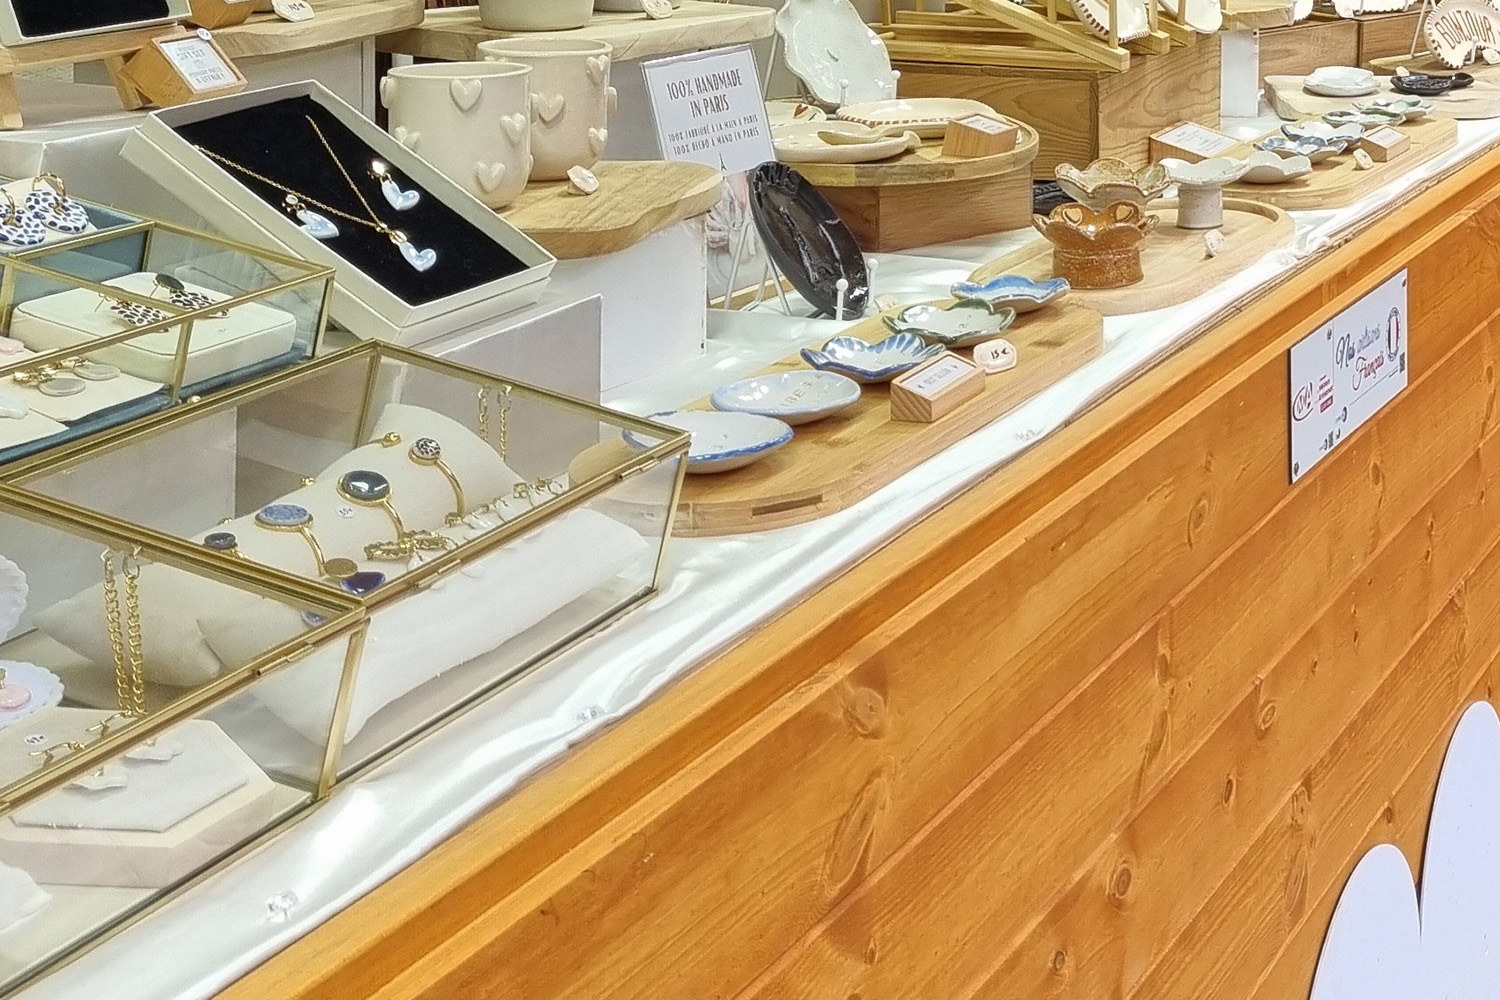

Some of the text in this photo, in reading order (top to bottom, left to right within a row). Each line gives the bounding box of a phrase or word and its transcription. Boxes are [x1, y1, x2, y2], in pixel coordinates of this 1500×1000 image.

[1434, 9, 1497, 51] BONJOUR
[667, 68, 742, 100] 100% HANDMADE
[689, 94, 730, 118] IN PARIS
[743, 114, 758, 124] PARIS
[673, 145, 690, 156] 100%
[716, 133, 733, 144] MANO
[734, 131, 742, 141] EN
[743, 126, 759, 138] PARIS
